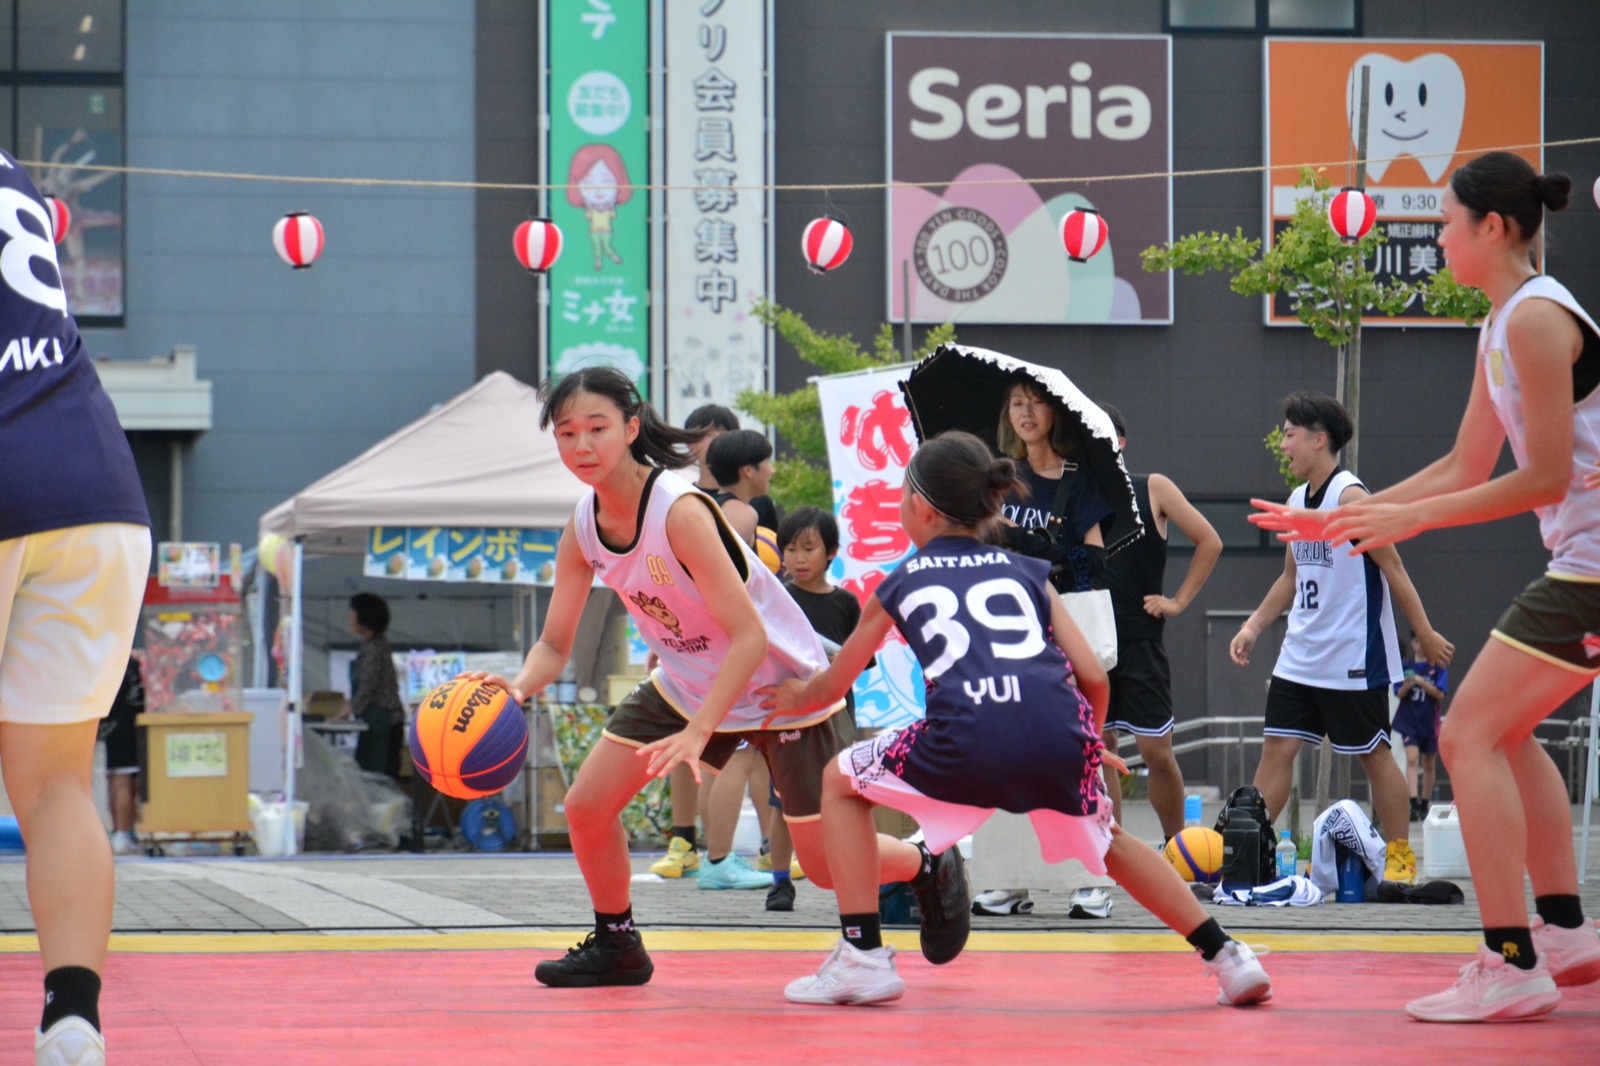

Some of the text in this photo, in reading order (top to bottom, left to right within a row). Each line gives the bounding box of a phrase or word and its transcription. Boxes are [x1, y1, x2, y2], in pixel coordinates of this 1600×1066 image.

[908, 61, 1152, 141] Seria
[1402, 194, 1438, 210] 9:30
[957, 209, 1001, 239] GOODS
[931, 235, 990, 275] 100
[372, 527, 556, 562] レインボー
[1294, 539, 1335, 566] ERDE
[646, 554, 675, 586] 99
[906, 552, 1011, 574] SAITAMA
[1300, 579, 1319, 609] 12
[898, 578, 1046, 681] 39
[963, 675, 1022, 705] YUI
